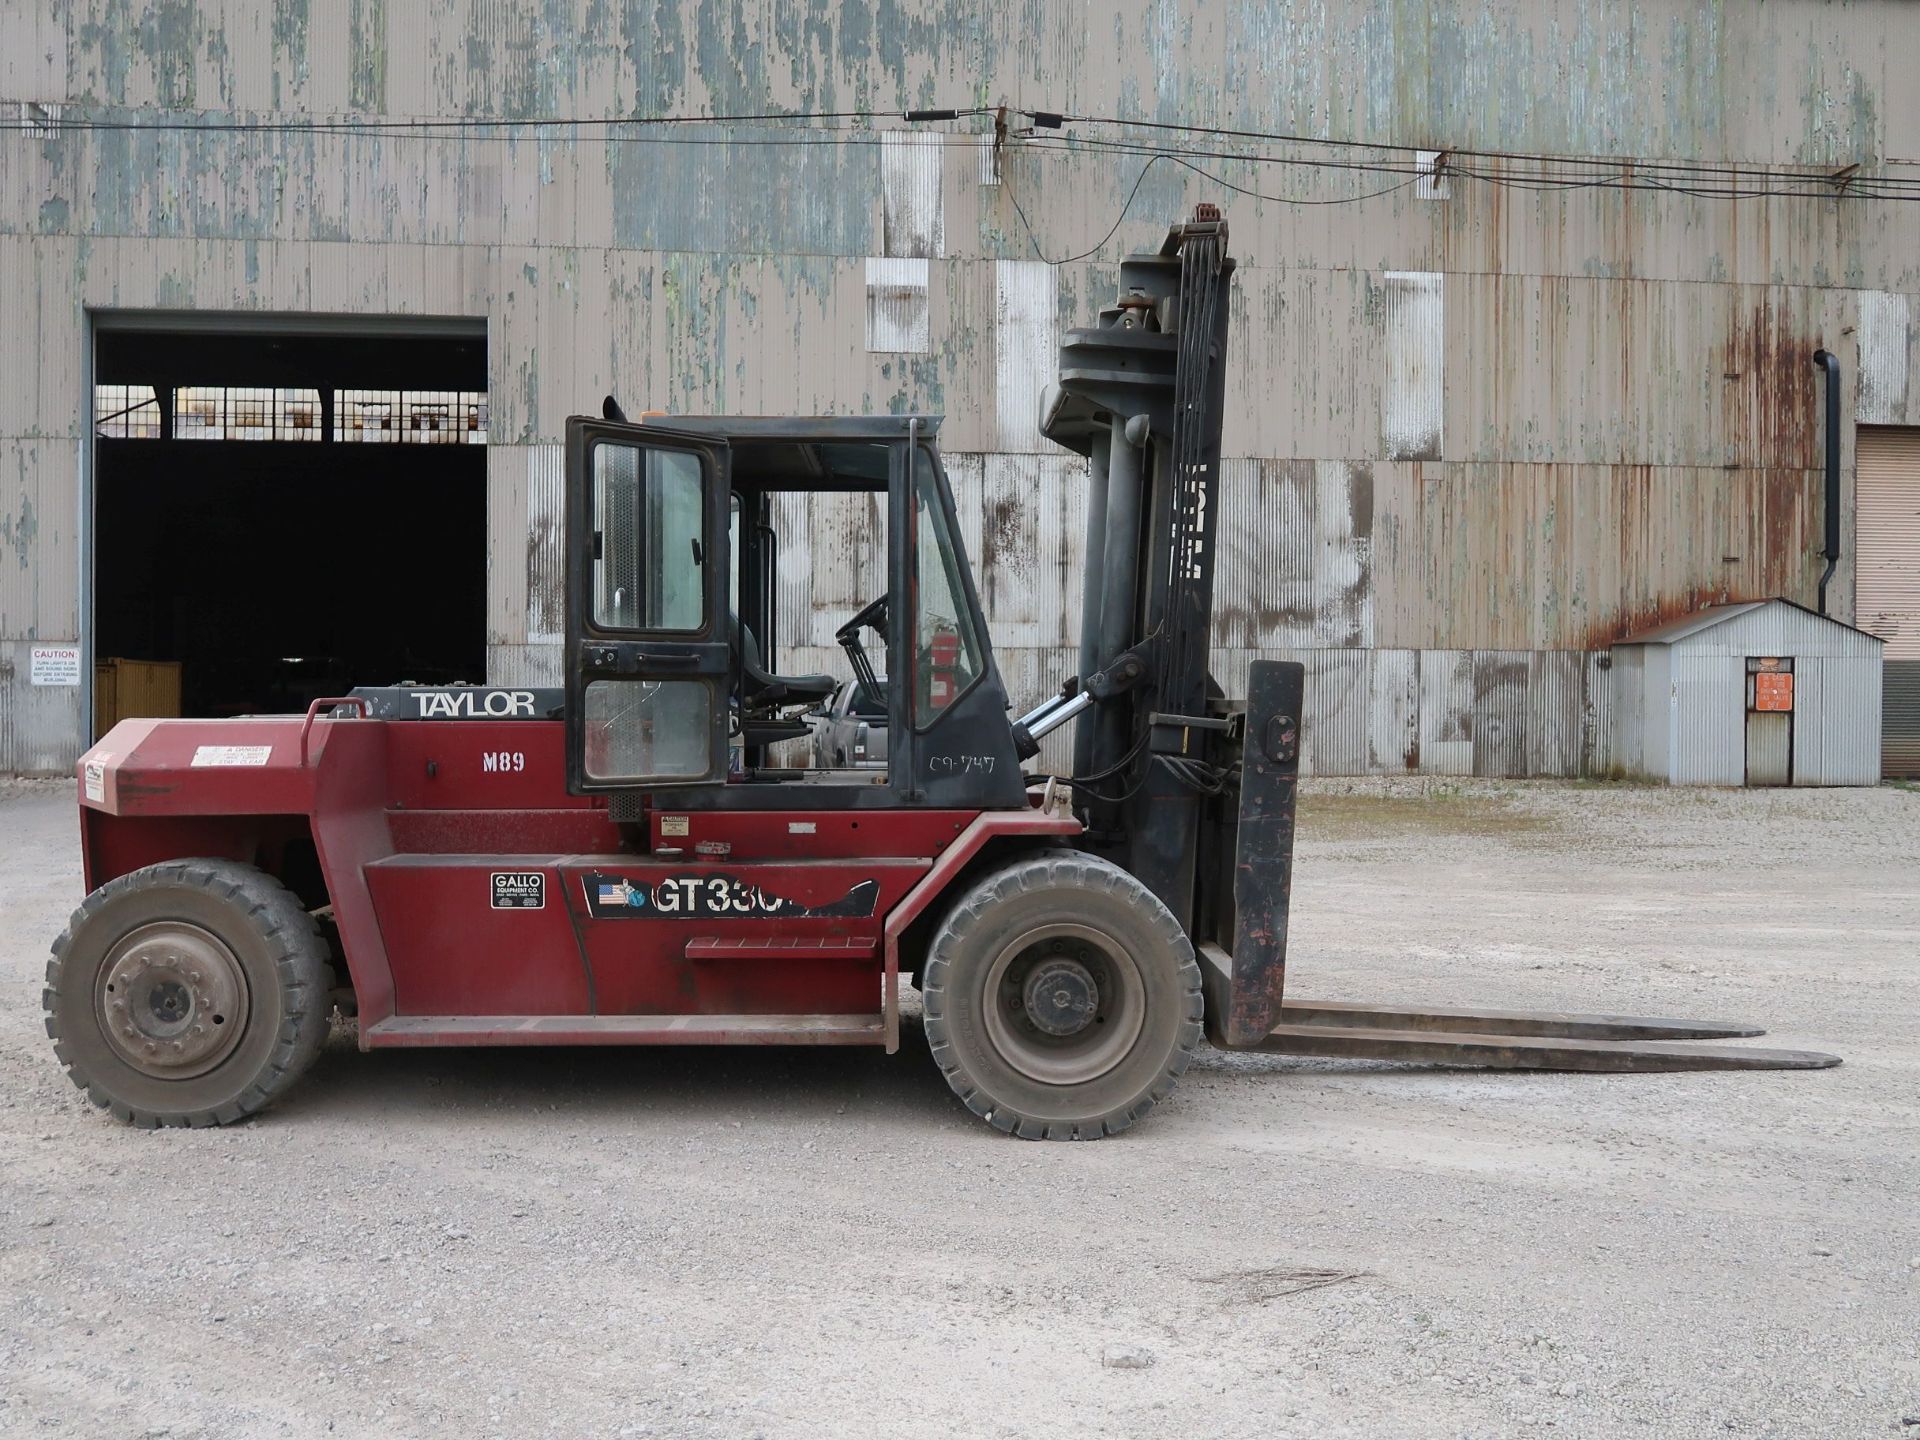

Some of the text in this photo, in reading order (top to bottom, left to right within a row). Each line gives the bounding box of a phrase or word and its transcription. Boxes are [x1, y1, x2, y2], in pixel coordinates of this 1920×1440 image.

[34, 650, 78, 658] CAUTION:
[410, 691, 536, 717] TAYLOR
[483, 752, 525, 772] M89
[495, 875, 540, 887] GALLO
